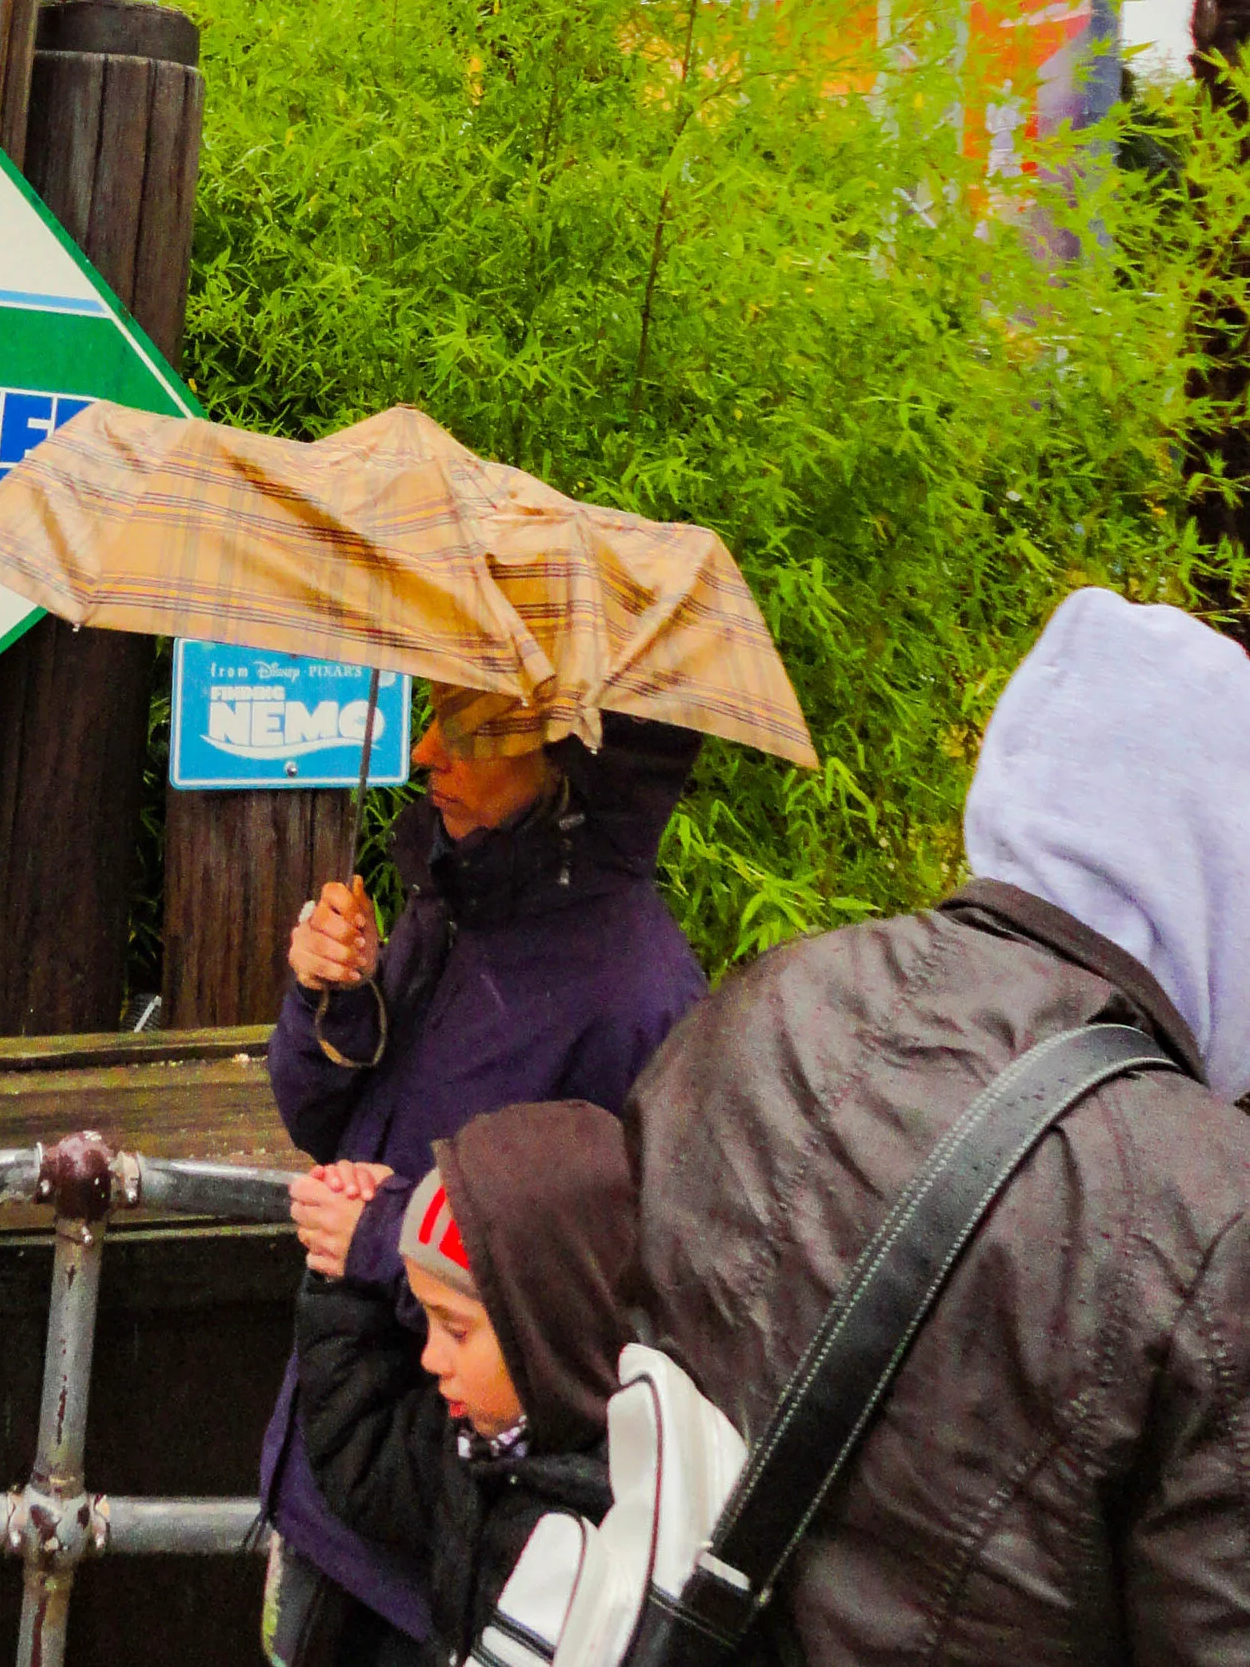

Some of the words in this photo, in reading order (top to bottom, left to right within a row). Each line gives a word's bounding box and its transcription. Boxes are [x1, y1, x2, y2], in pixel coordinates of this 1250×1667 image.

[210, 662, 248, 678] from
[308, 665, 363, 679] PIXAR'S
[210, 686, 286, 701] FINDING
[208, 699, 386, 748] NEMO
